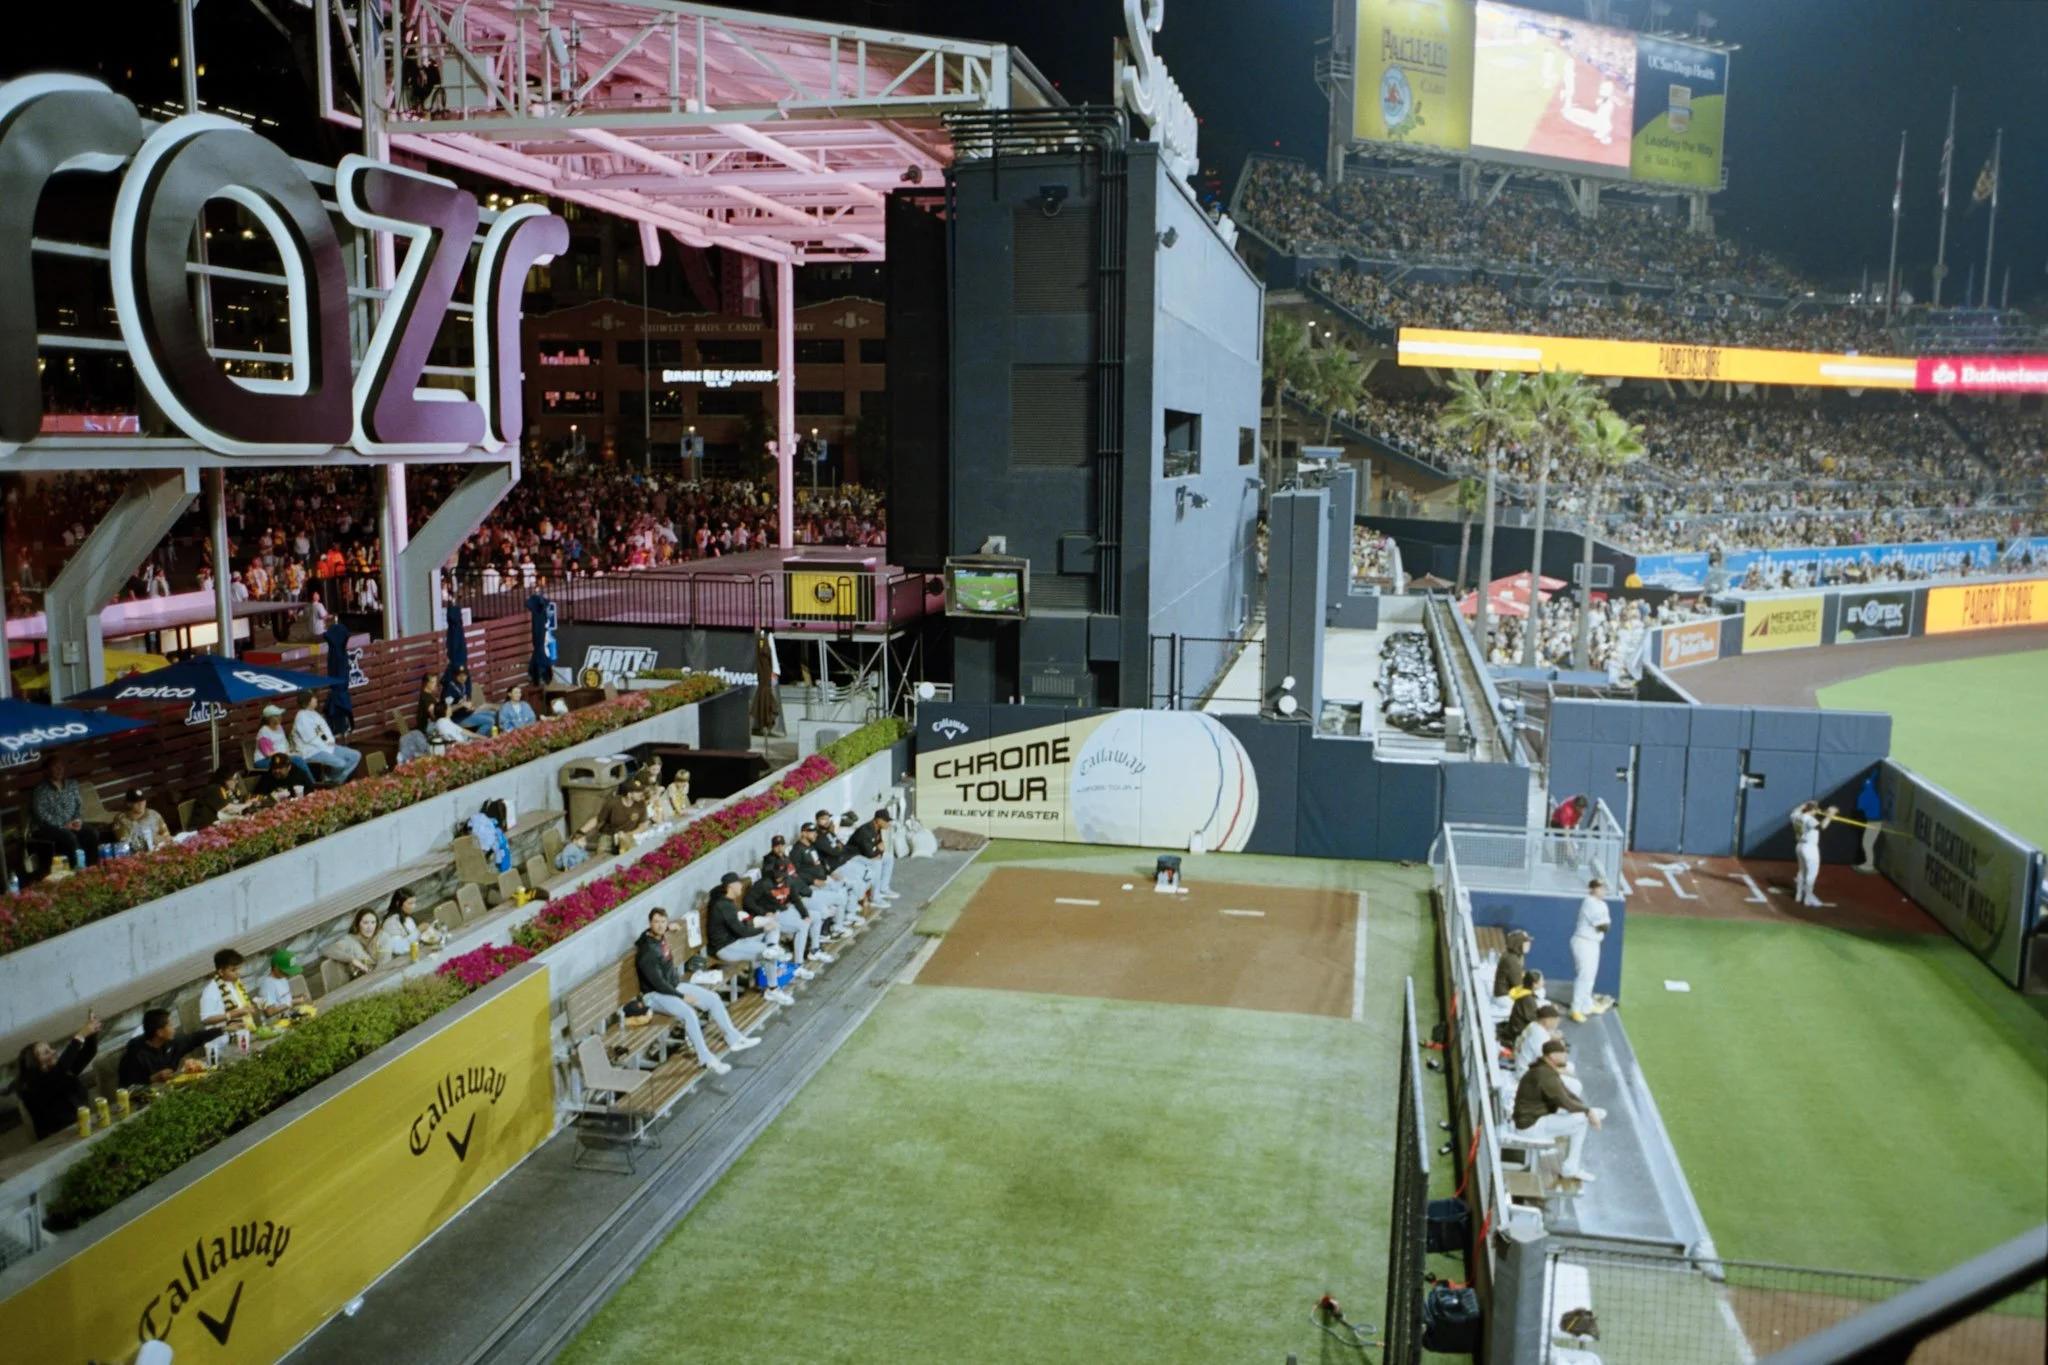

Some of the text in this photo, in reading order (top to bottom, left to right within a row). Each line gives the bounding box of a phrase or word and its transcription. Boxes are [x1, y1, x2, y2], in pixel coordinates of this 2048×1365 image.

[1771, 609, 1817, 624] MERCURY
[1963, 584, 2035, 626] PADRES SCORE
[1770, 621, 1817, 634] INSURANCE
[587, 649, 645, 672] PARTY
[116, 686, 196, 699] petco
[0, 723, 88, 750] petco
[932, 718, 969, 734] Callaway
[934, 737, 1070, 779] CHROME
[1080, 747, 1146, 776] Callaway
[956, 776, 1047, 802] TOUR
[944, 809, 1059, 820] BELIEVE IN FASTER
[410, 1066, 506, 1156] Callaway
[139, 1220, 290, 1342] Callaway
